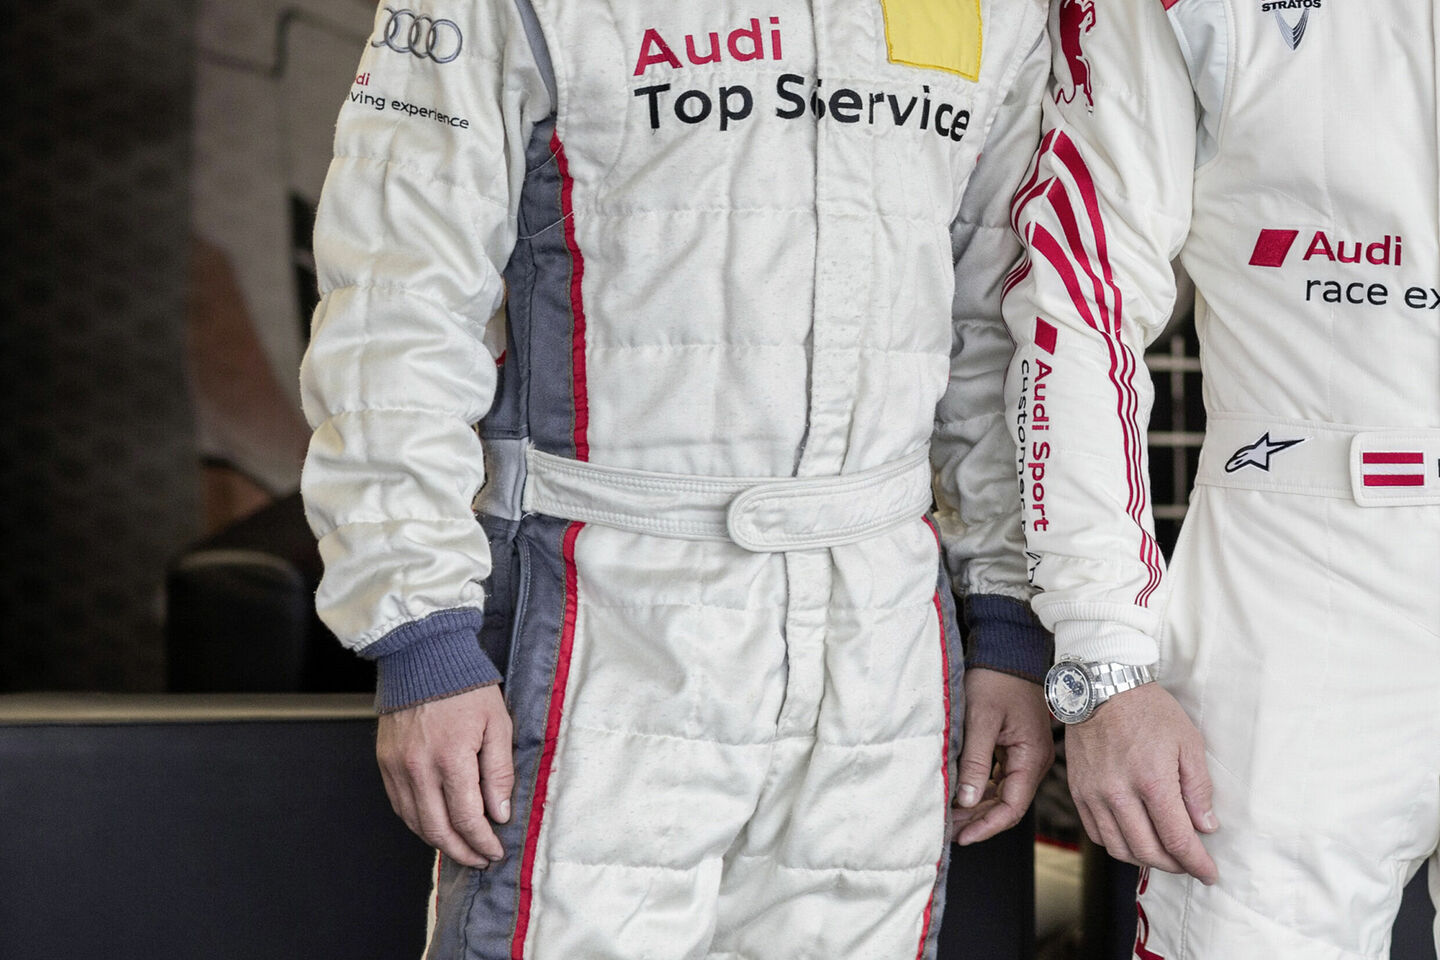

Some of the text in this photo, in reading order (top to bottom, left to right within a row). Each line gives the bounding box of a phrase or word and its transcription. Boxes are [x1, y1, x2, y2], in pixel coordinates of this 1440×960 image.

[633, 16, 782, 77] Audi
[355, 72, 371, 87] di
[351, 91, 470, 129] ving experience
[633, 73, 971, 142] Top Service
[1302, 230, 1402, 267] Audi
[1305, 278, 1389, 306] race
[1031, 358, 1053, 431] Audi
[1028, 442, 1051, 532] Sport
